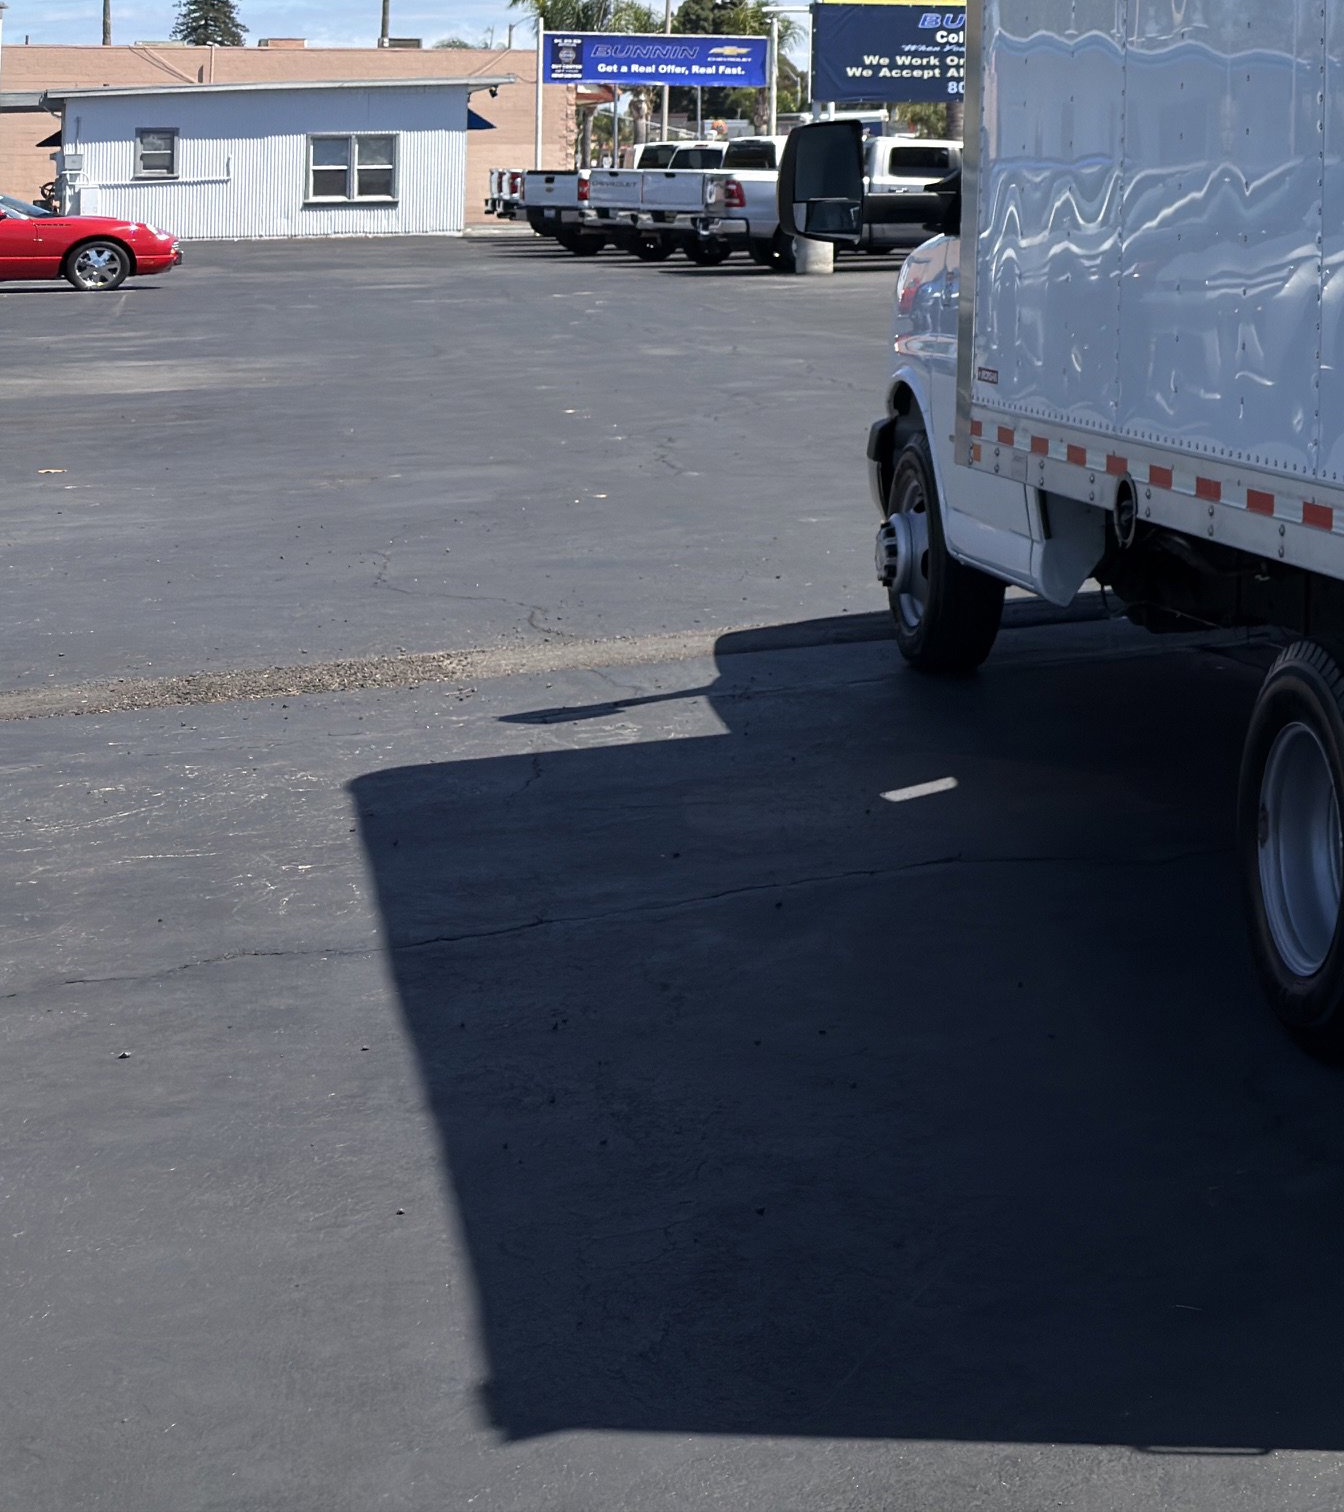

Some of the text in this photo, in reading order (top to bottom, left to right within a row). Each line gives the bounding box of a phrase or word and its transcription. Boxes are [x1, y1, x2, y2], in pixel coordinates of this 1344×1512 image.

[591, 44, 699, 59] BUNNIN
[864, 55, 889, 66] We
[896, 55, 940, 66] Work
[597, 63, 745, 75] Get a Real Offer, Real Fast.
[846, 66, 873, 77] We
[878, 66, 940, 79] Accept
